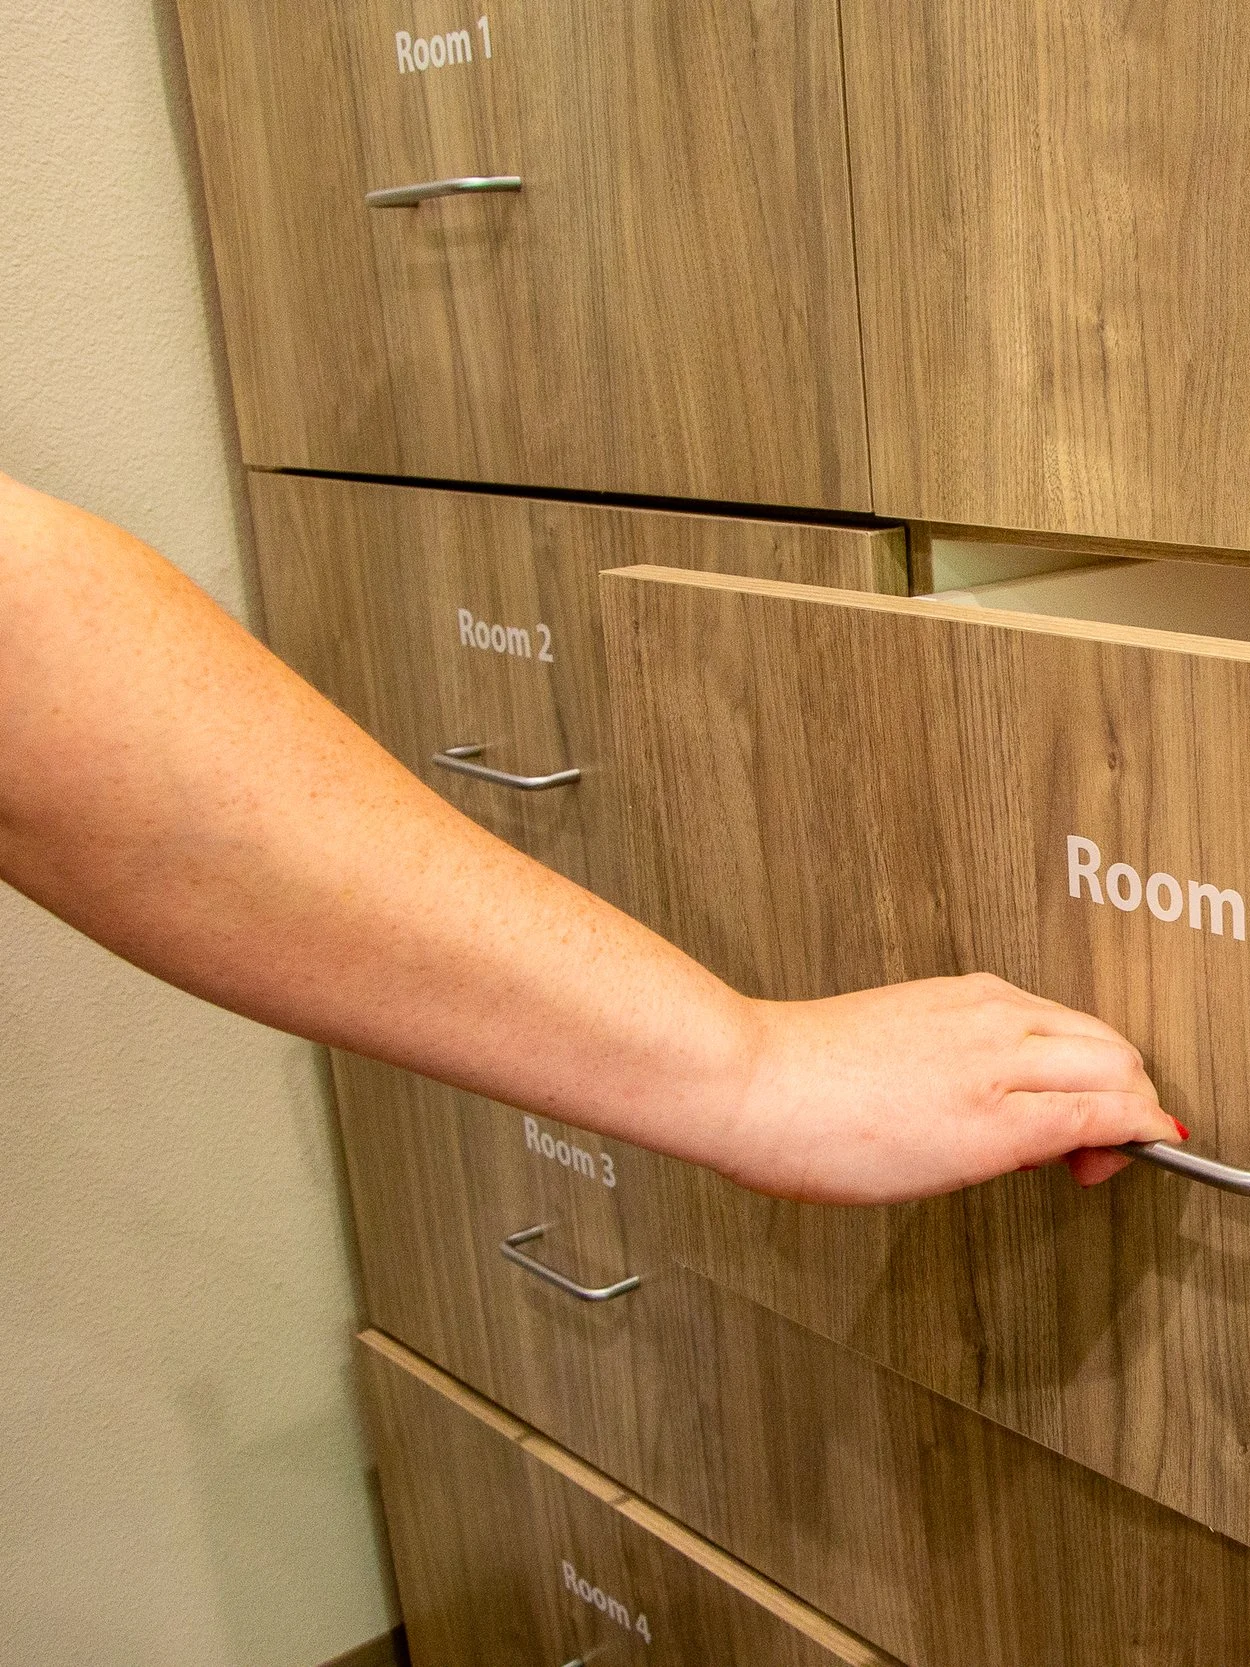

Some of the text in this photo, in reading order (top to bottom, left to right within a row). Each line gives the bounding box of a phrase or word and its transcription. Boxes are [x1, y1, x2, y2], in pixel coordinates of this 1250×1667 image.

[395, 16, 492, 74] Room 1
[458, 608, 555, 663] Room 2
[1066, 834, 1246, 942] Room
[524, 1116, 616, 1188] Room 3
[562, 1560, 651, 1644] Room 4
